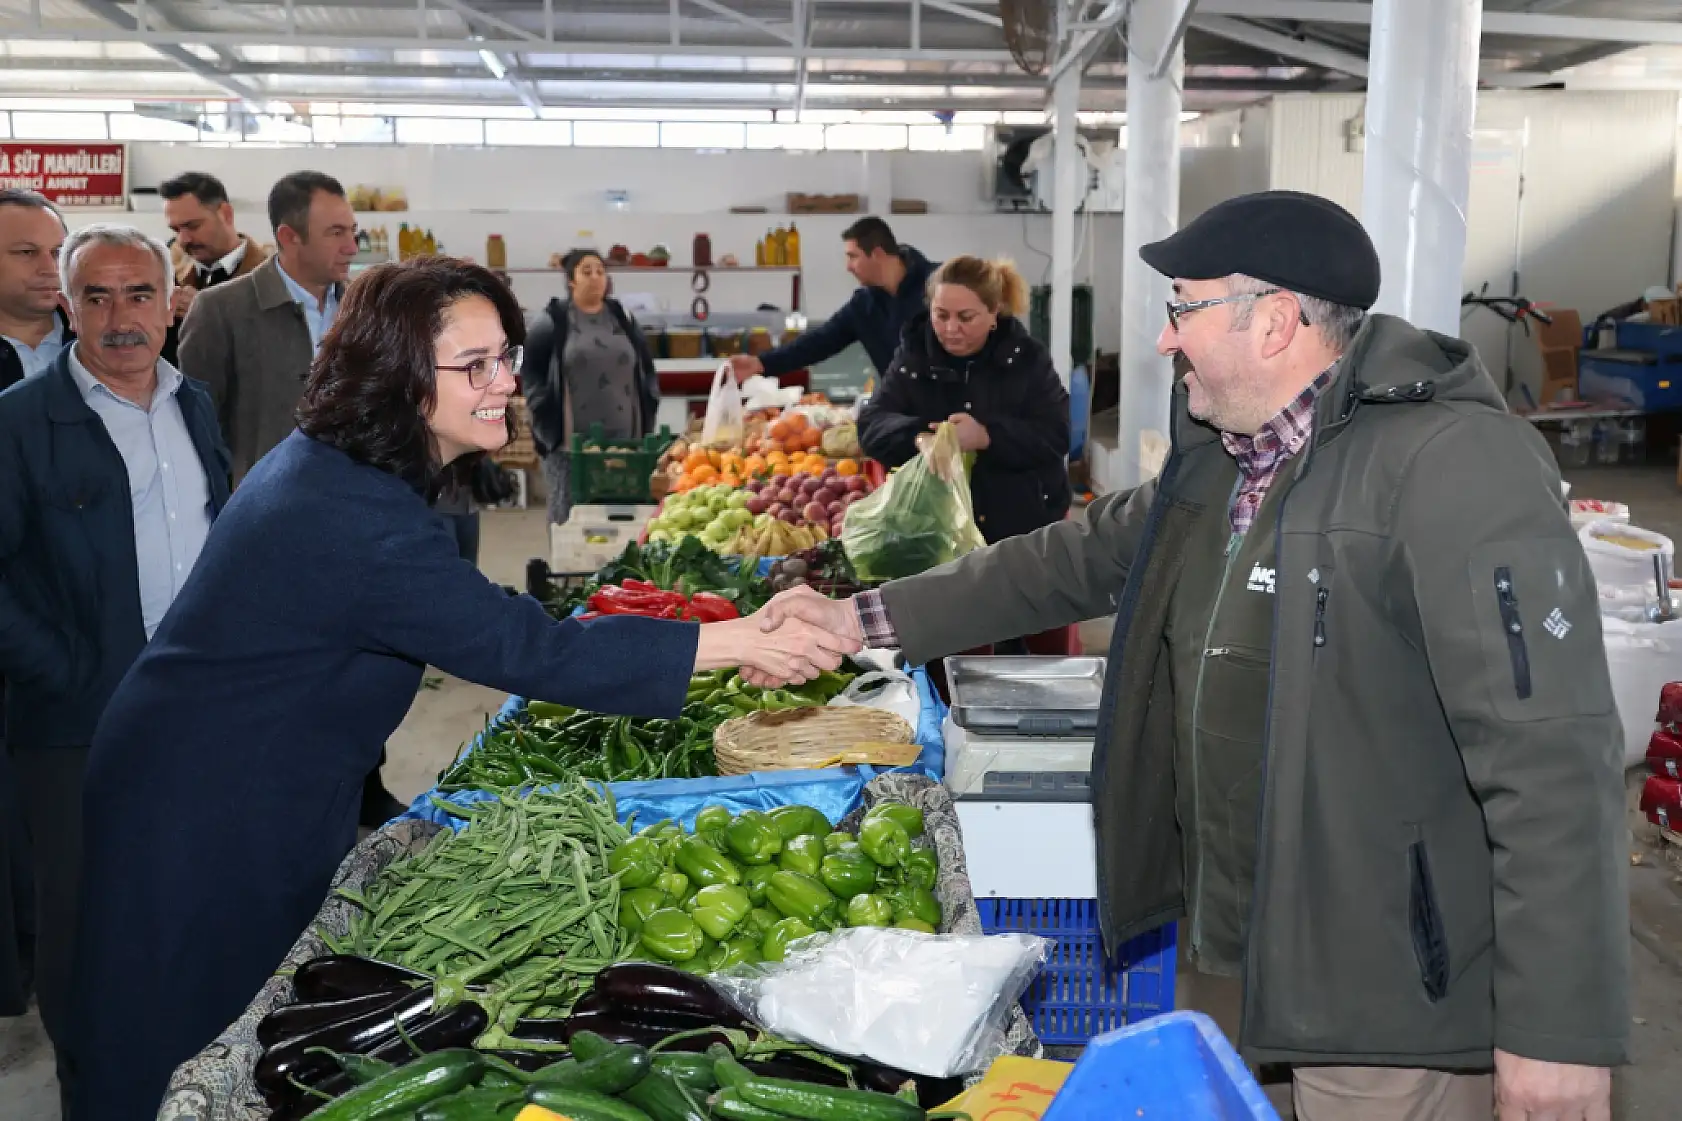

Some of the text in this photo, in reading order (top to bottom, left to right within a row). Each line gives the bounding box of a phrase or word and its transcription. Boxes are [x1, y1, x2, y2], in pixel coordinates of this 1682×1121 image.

[14, 149, 41, 174] SÜT
[43, 149, 122, 174] MAMÜLLERİ
[46, 176, 88, 189] AHMET
